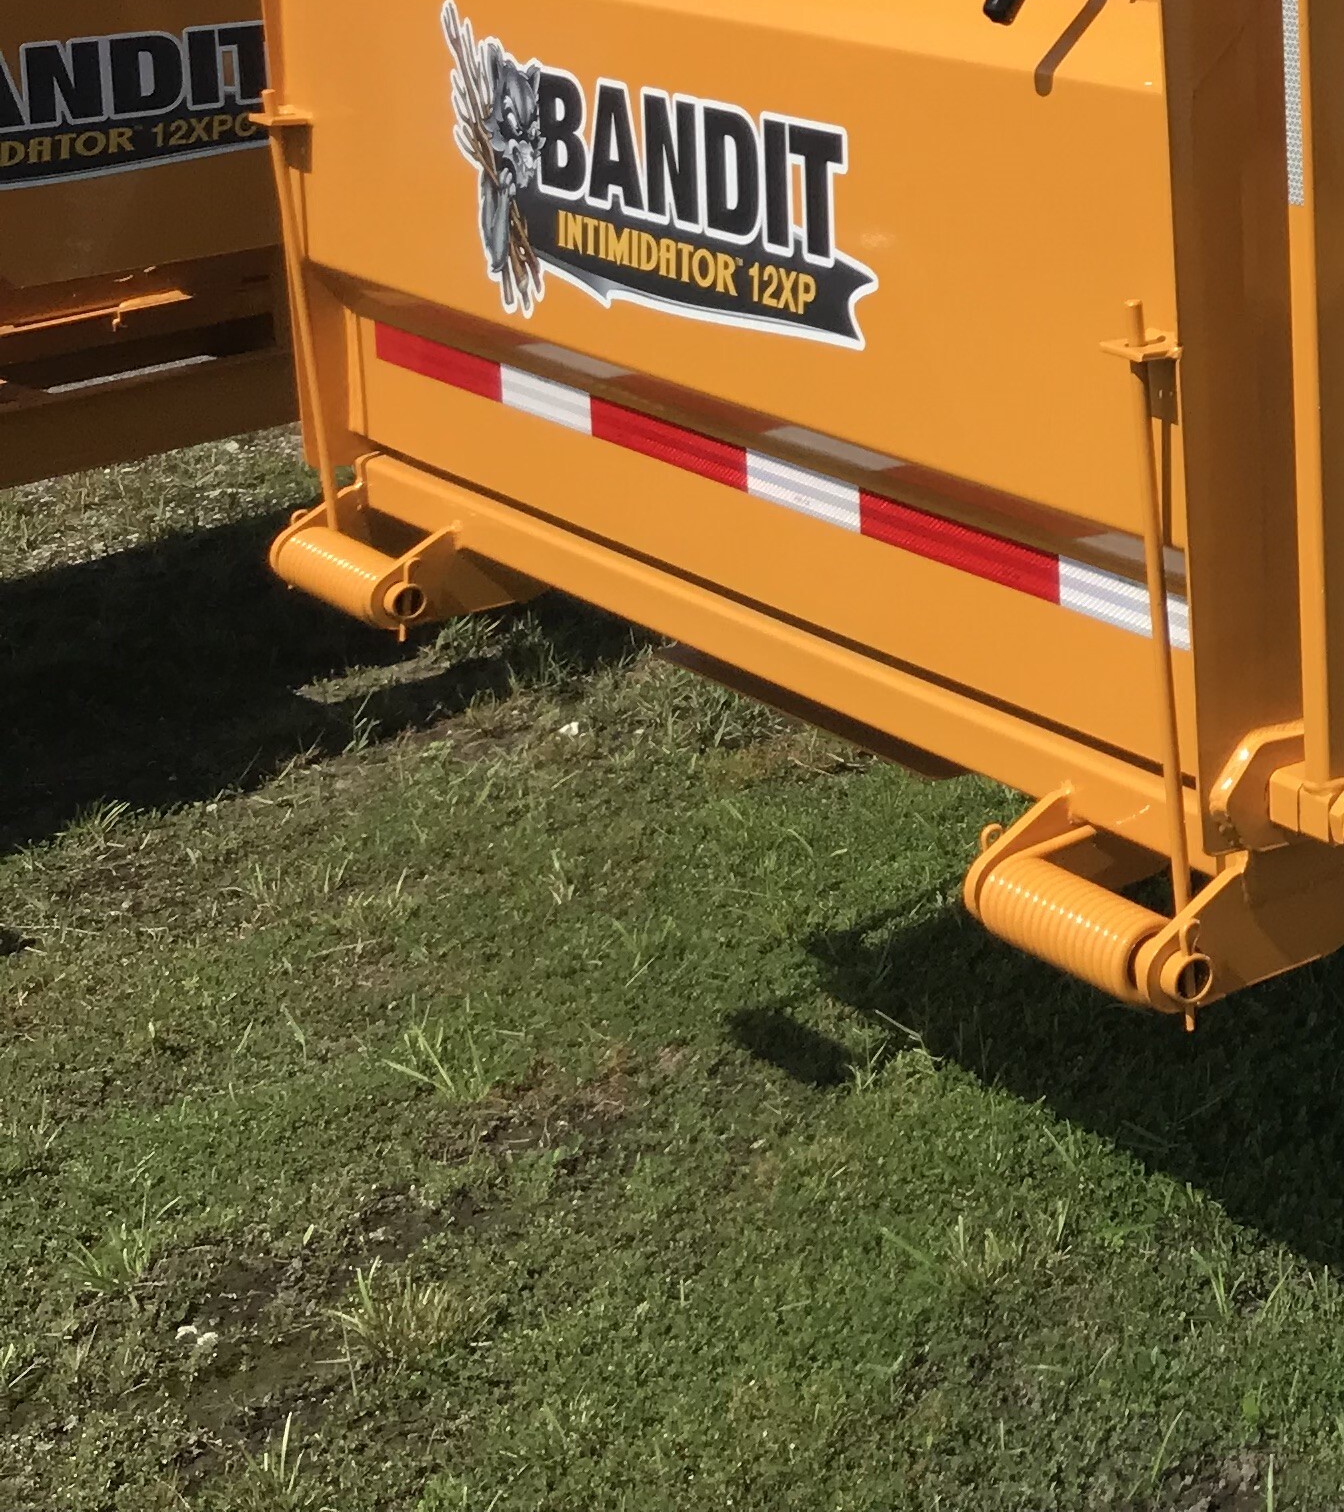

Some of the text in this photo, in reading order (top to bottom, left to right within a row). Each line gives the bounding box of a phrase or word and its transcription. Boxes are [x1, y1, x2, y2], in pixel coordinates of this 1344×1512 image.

[537, 70, 846, 261] BANDIT
[557, 209, 817, 315] INTIMIDATOR 12XP
